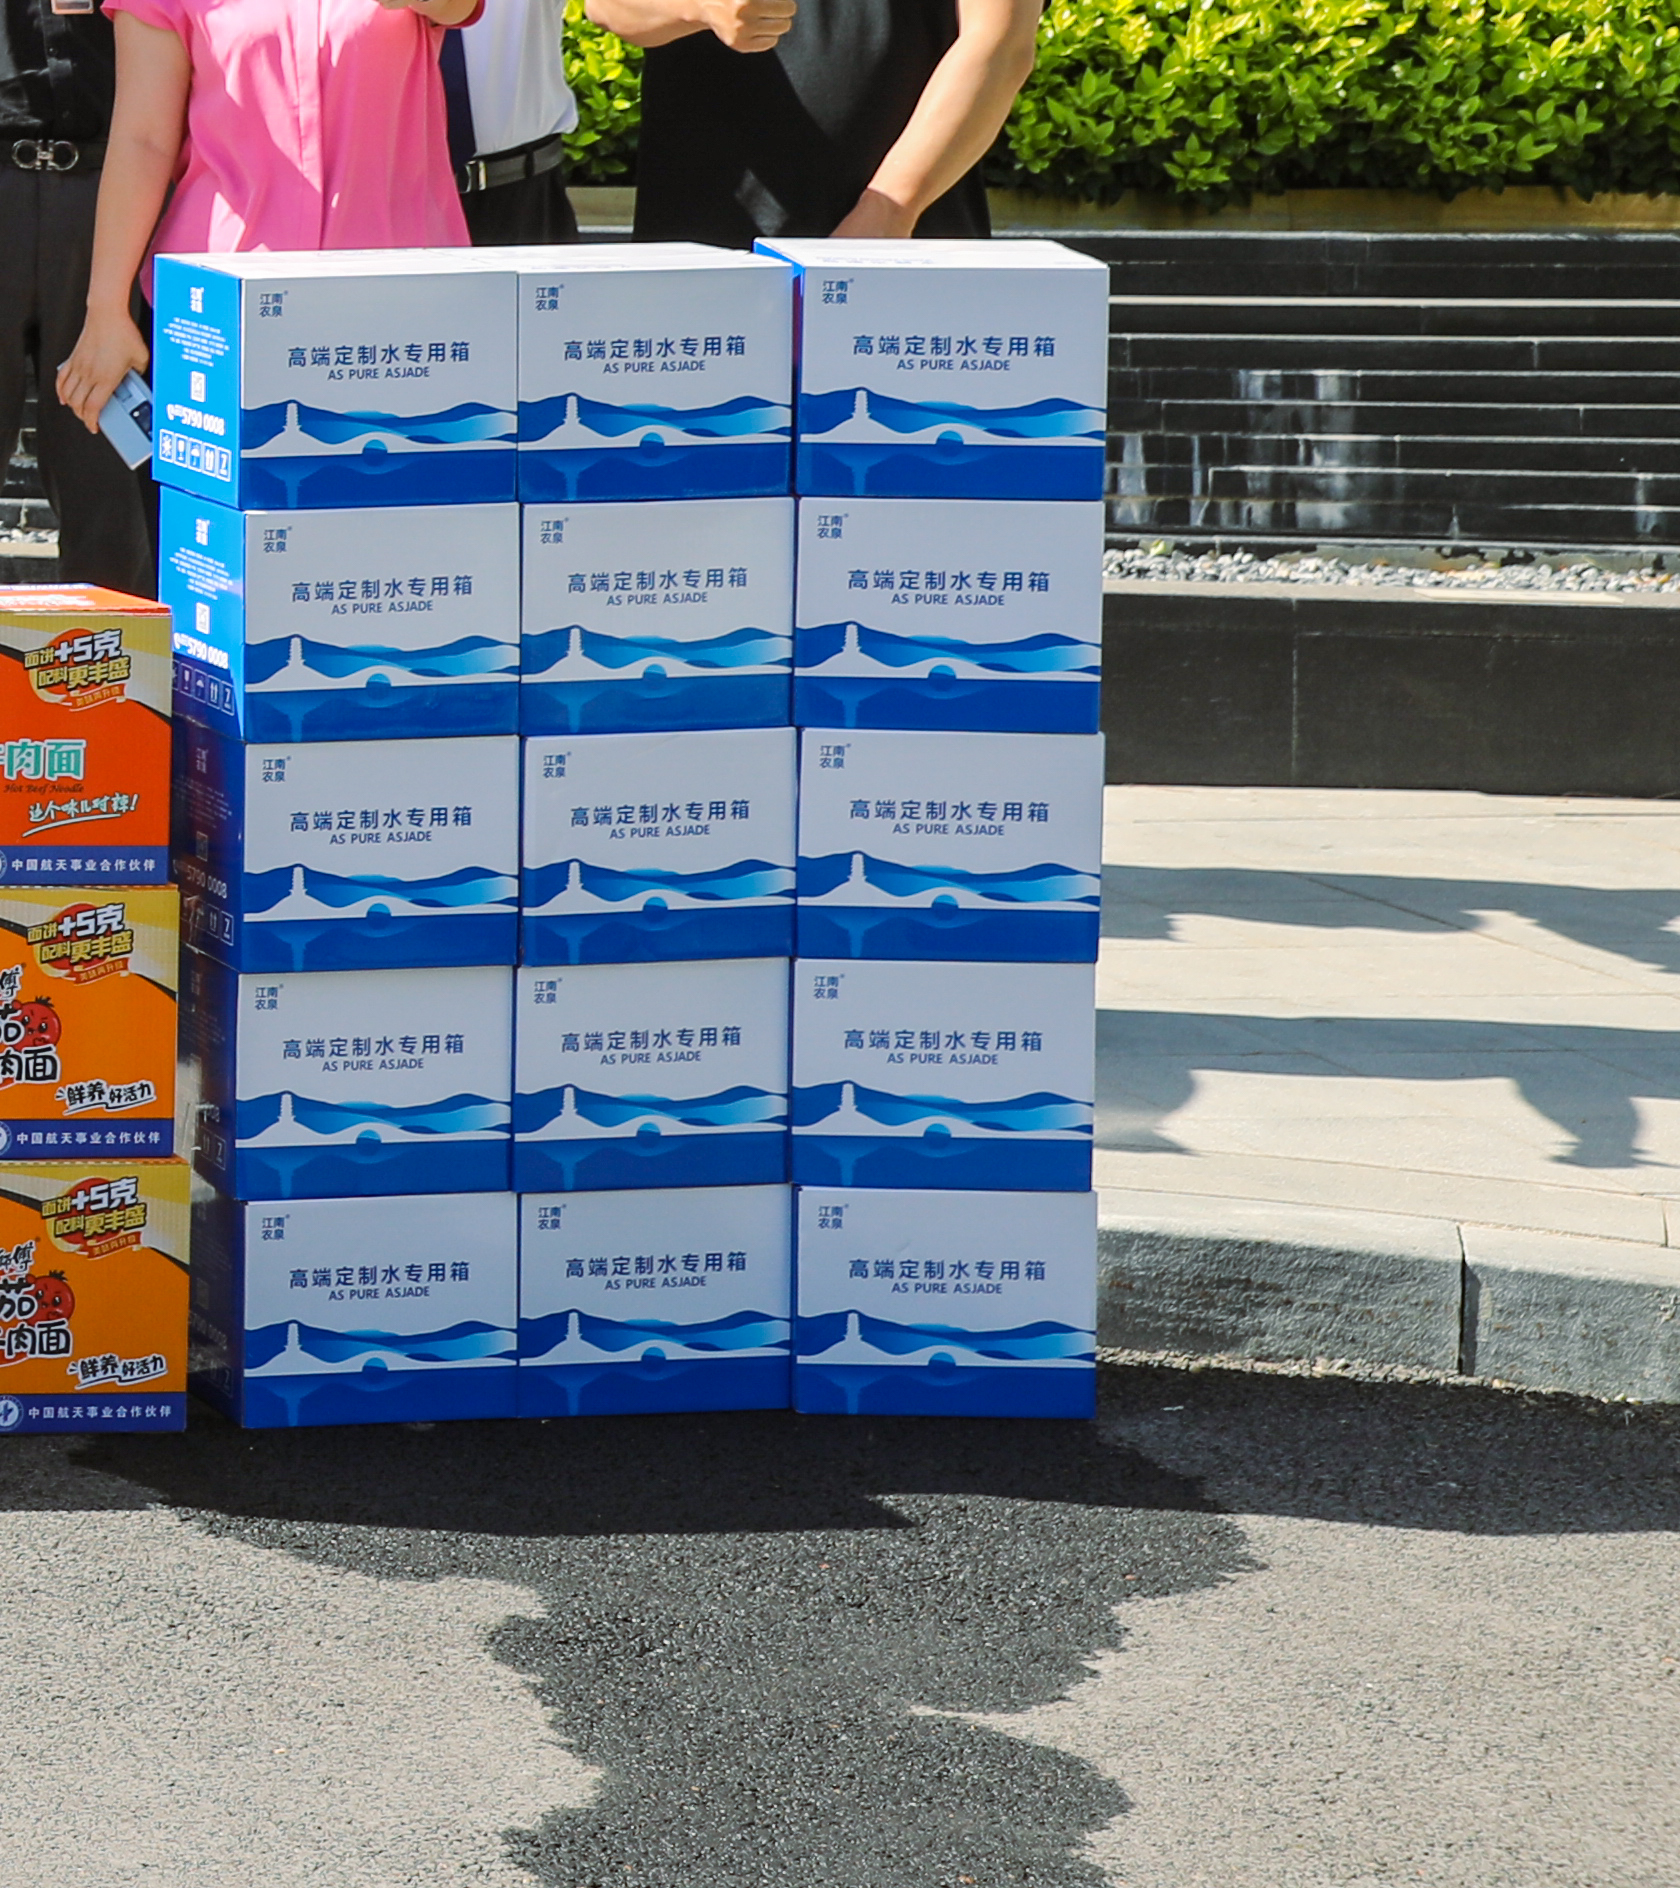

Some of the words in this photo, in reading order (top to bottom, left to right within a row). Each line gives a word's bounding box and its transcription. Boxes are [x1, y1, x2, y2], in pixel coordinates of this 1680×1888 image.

[287, 342, 470, 369] 高端定制水专用箱
[563, 335, 746, 361] 高端定制水专用箱
[853, 334, 1056, 361] 高端定制水专用箱
[325, 364, 344, 381] AS
[348, 367, 379, 380] PURE
[384, 366, 430, 379] ASJADE
[601, 359, 620, 374] AS
[625, 358, 655, 373] PURE
[660, 356, 706, 372] ASJADE
[896, 358, 915, 370] AS
[920, 359, 954, 371] PURE
[960, 359, 1010, 371] ASJADE
[289, 805, 473, 835] 高端定制水专用箱
[569, 799, 750, 828] 高端定制水专用箱
[849, 799, 1049, 827] 高端定制水专用箱
[11, 858, 156, 872] 中国航天事业合作伙伴
[288, 1261, 470, 1290] 高端定制水专用箱
[564, 1251, 748, 1281] 高端定制水专用箱
[848, 1257, 1047, 1285] 高端定制水专用箱
